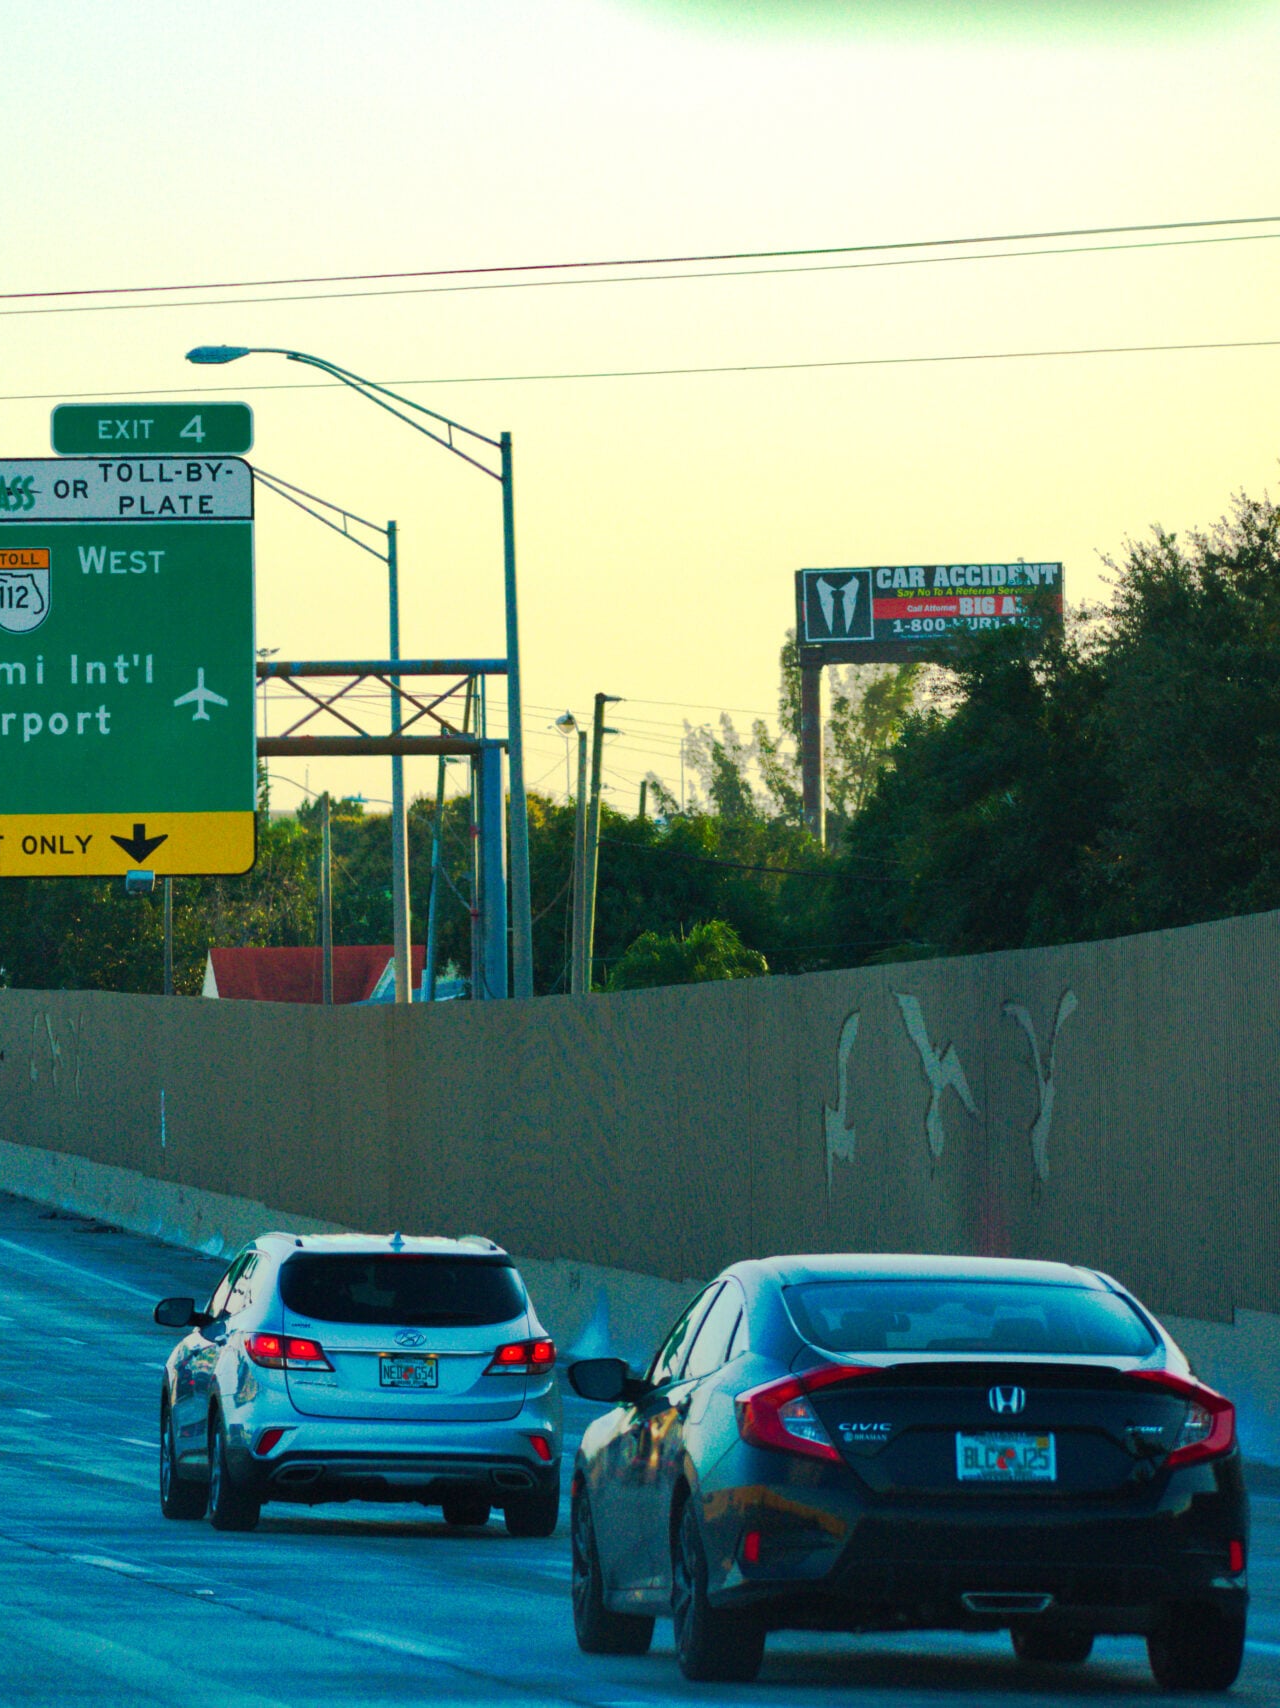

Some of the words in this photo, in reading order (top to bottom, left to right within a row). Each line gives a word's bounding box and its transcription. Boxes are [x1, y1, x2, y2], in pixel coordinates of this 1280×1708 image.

[98, 420, 154, 439] EXIT
[179, 415, 206, 443] 4
[98, 462, 233, 483] TOLL-BY-
[53, 480, 89, 499] OR
[119, 495, 213, 515] PLATE
[0, 553, 40, 566] TOLL
[78, 546, 165, 574] WEST
[876, 567, 926, 589] CAR
[933, 564, 1058, 587] ACCIDENT
[0, 586, 29, 609] 112
[897, 588, 914, 599] Say
[917, 588, 931, 597] No
[934, 587, 943, 596] To
[946, 587, 953, 596] A
[955, 586, 995, 595] Referral
[924, 604, 957, 612] Attorney
[959, 596, 995, 615] BIG
[71, 654, 153, 684] Int'l
[21, 834, 93, 855] ONLY
[838, 1422, 892, 1431] CIVIC
